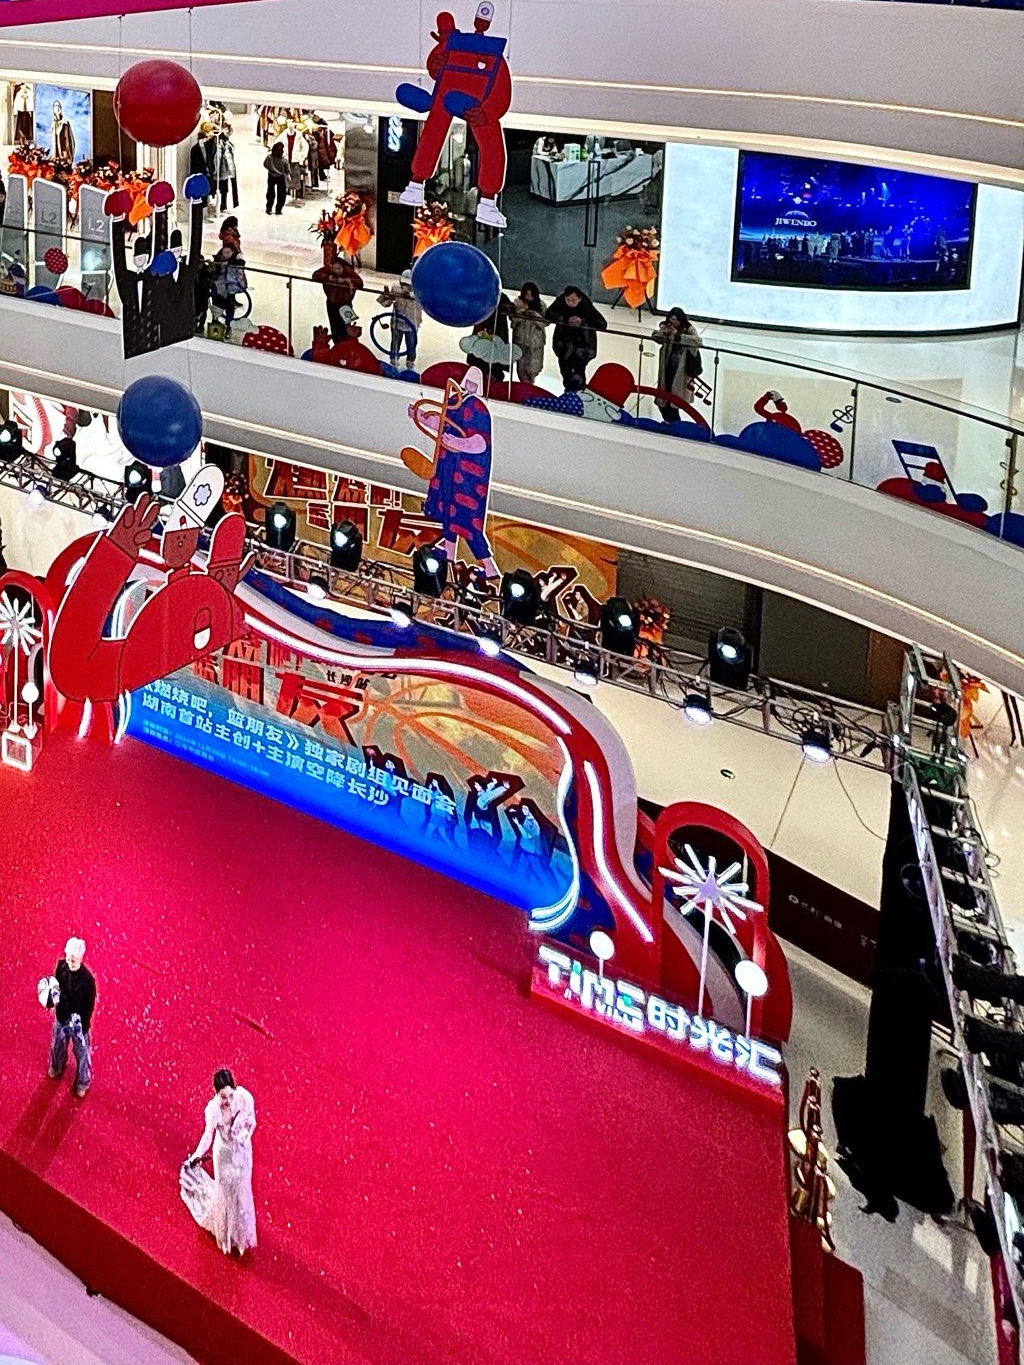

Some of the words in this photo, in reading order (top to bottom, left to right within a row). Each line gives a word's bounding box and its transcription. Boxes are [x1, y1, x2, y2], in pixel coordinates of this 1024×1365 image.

[88, 218, 105, 233] L2
[647, 994, 783, 1085] 时光汇
